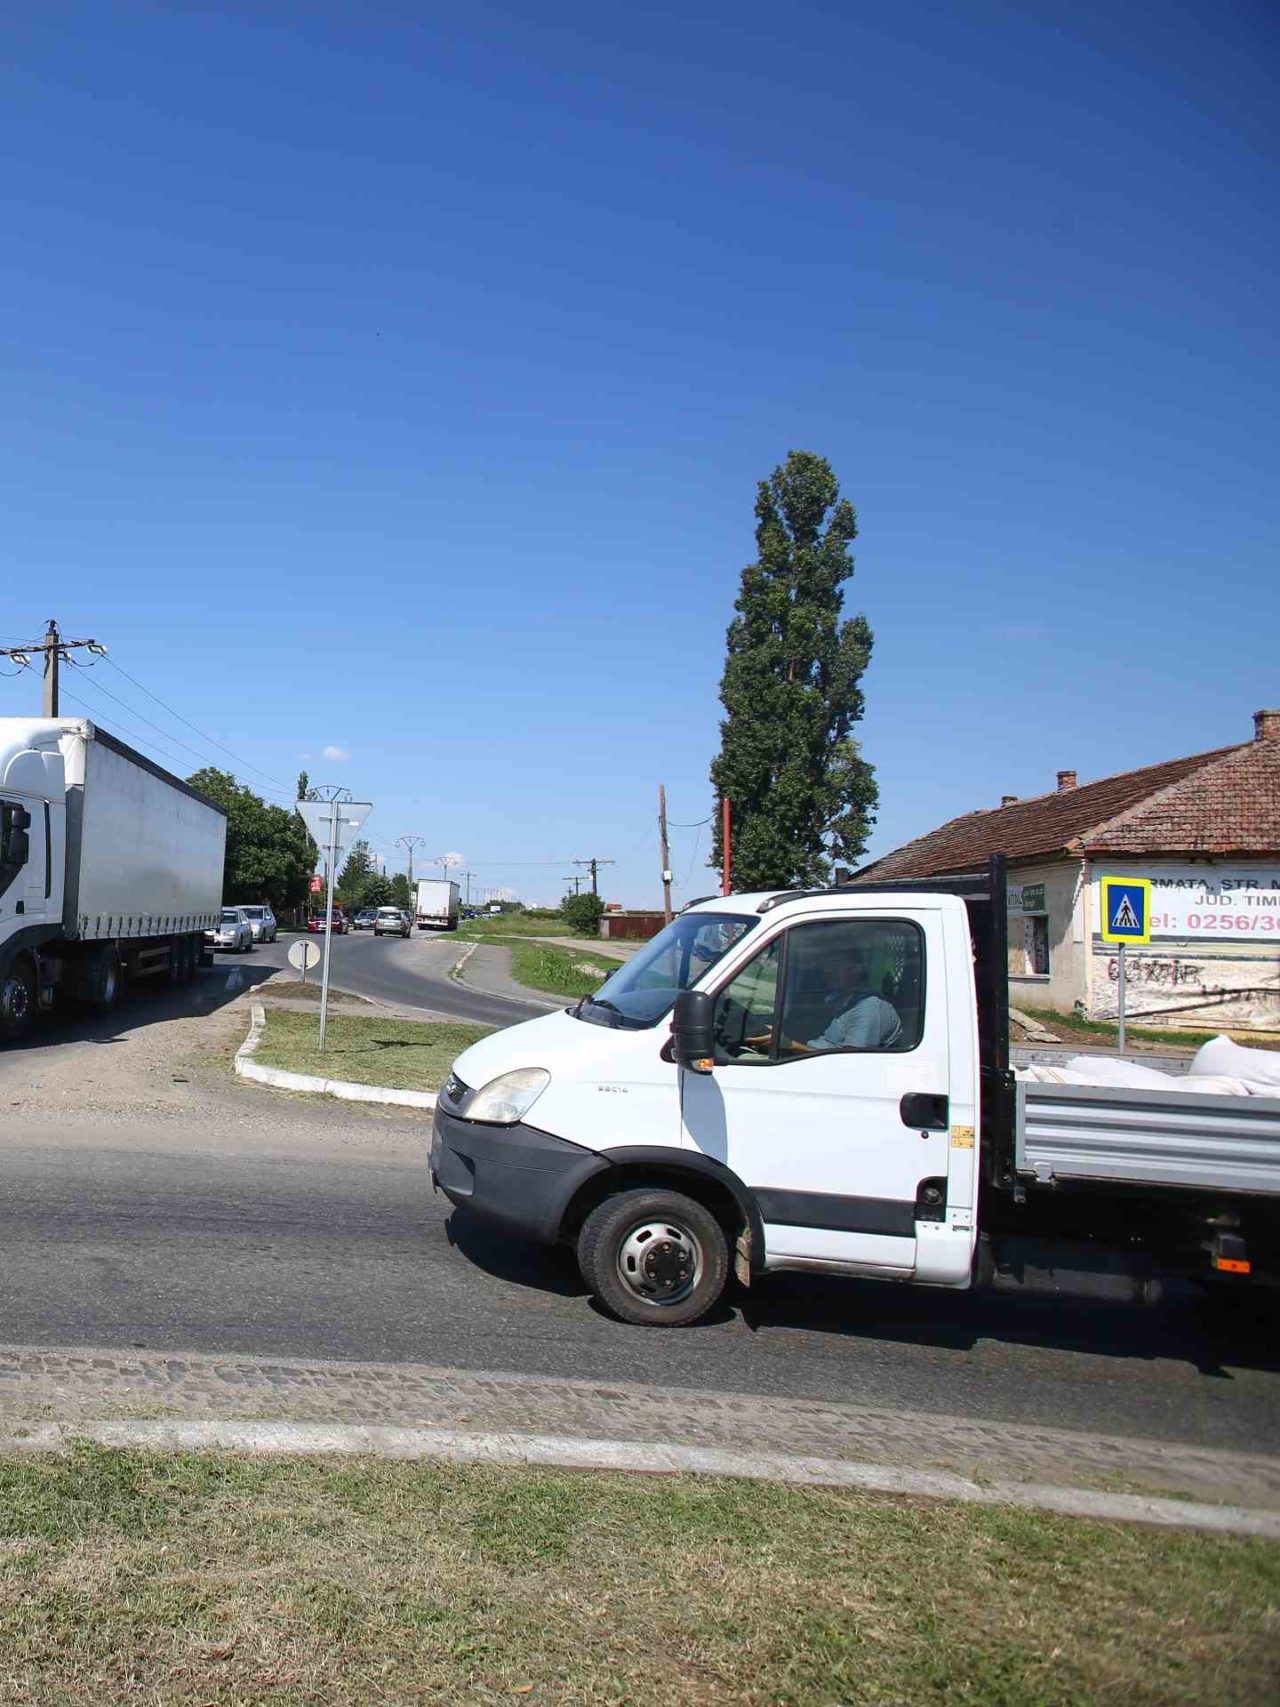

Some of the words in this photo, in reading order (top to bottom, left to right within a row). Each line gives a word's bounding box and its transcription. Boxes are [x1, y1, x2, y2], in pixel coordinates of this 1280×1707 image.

[1150, 878, 1214, 891] RMATA,
[1221, 879, 1264, 891] STR.
[1194, 895, 1237, 906] JUD.
[1150, 913, 1175, 927] el:
[1187, 913, 1280, 930] 0256/3
